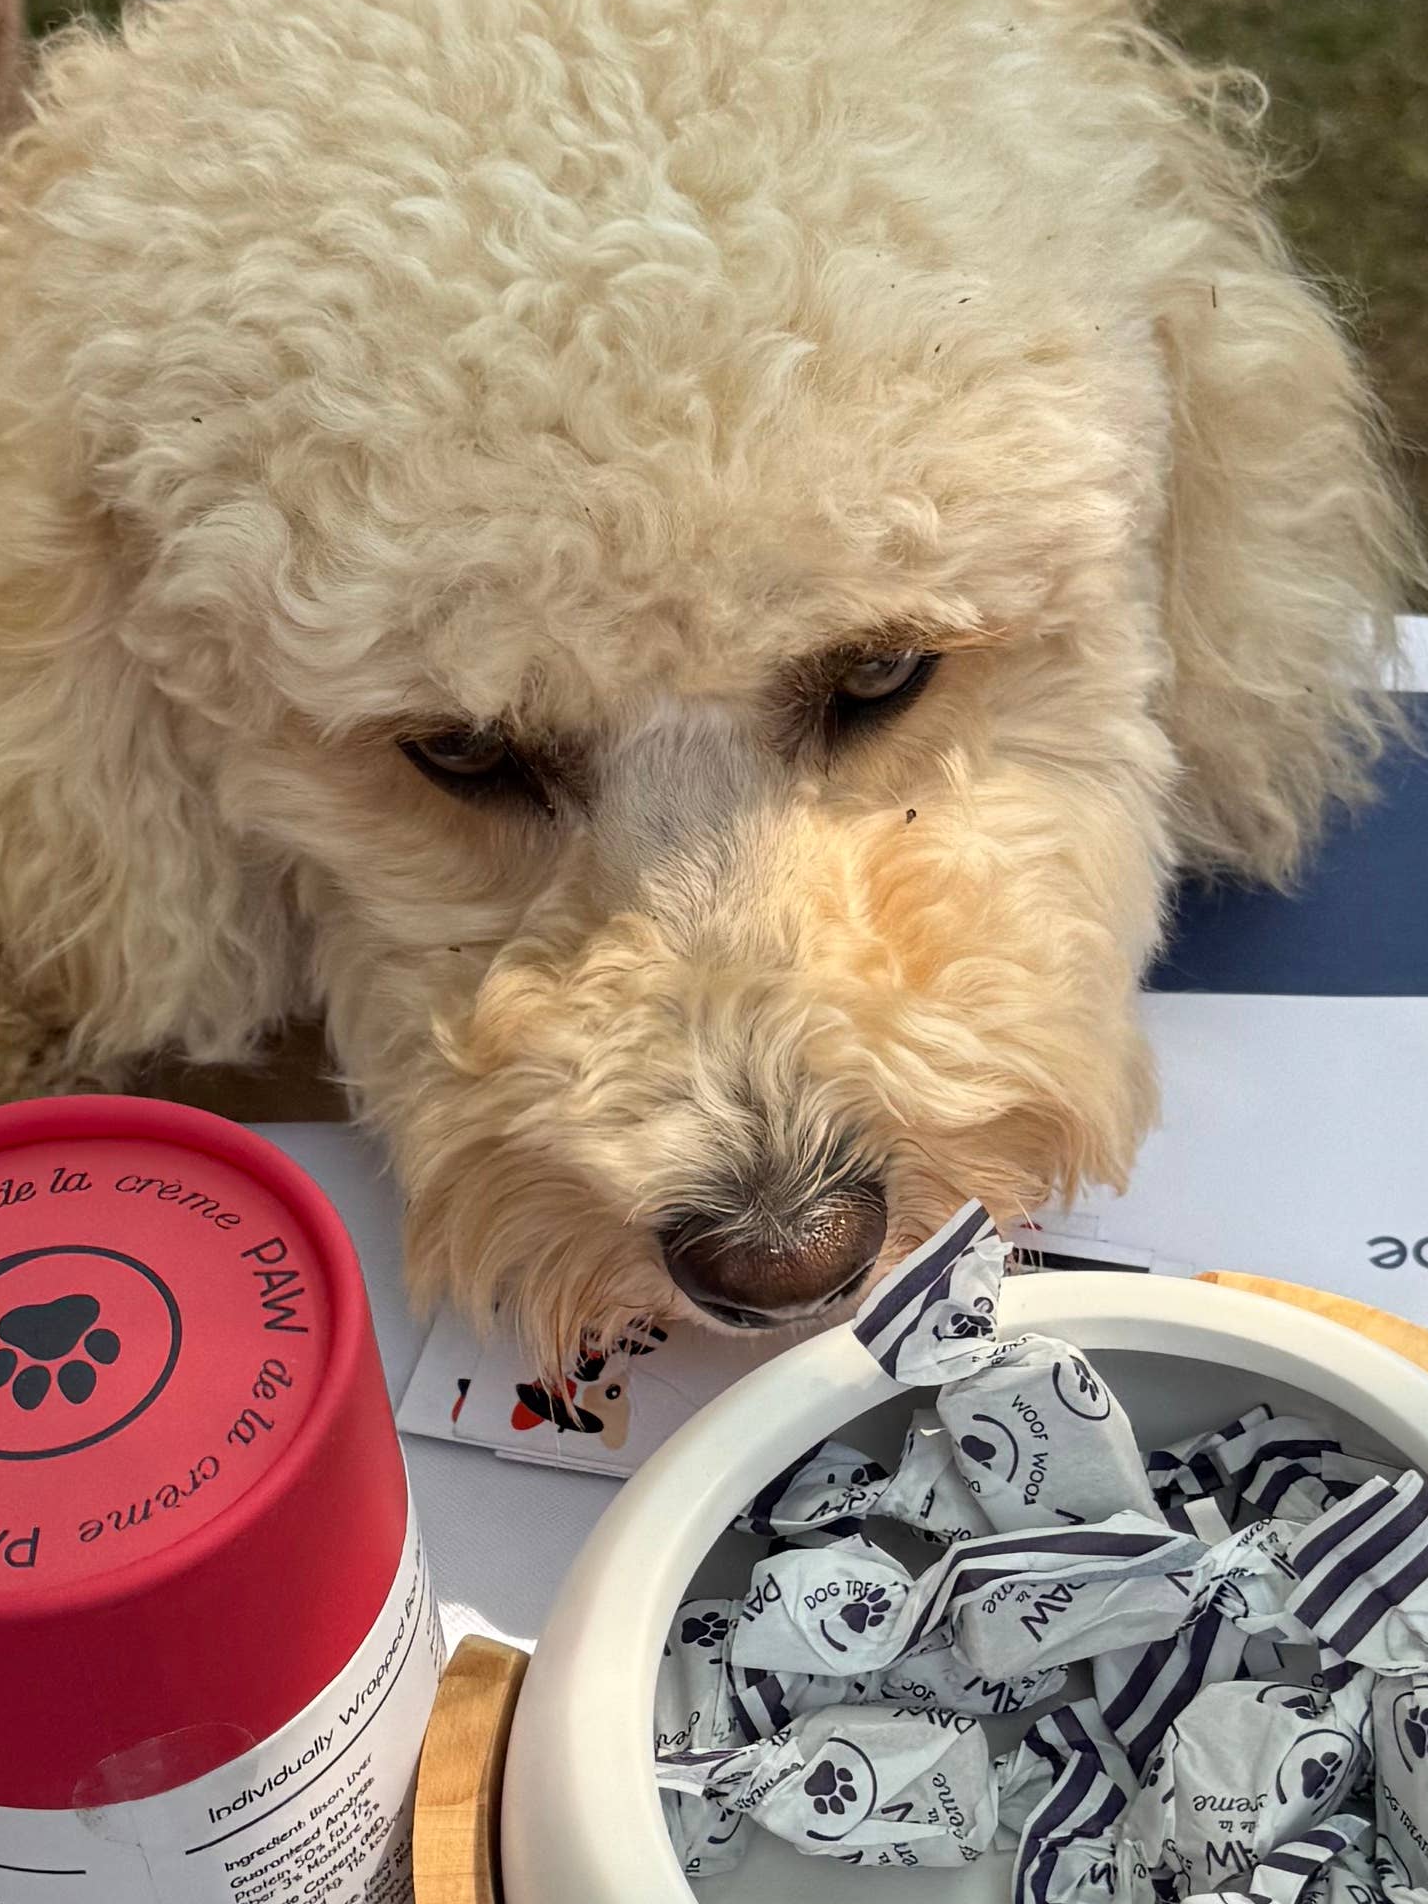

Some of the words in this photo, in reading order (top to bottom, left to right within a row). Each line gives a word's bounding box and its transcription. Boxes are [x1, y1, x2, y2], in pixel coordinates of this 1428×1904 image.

[49, 1167, 93, 1194] la
[240, 1237, 309, 1333] PAW
[251, 1359, 293, 1401] de
[226, 1408, 275, 1446] la
[1011, 1394, 1048, 1441] WOOF
[1022, 1451, 1049, 1506] WOOF
[803, 1582, 841, 1611] DOG
[1020, 1582, 1075, 1643] AW
[208, 1728, 334, 1825] Individually
[339, 1616, 405, 1724] Wrapped
